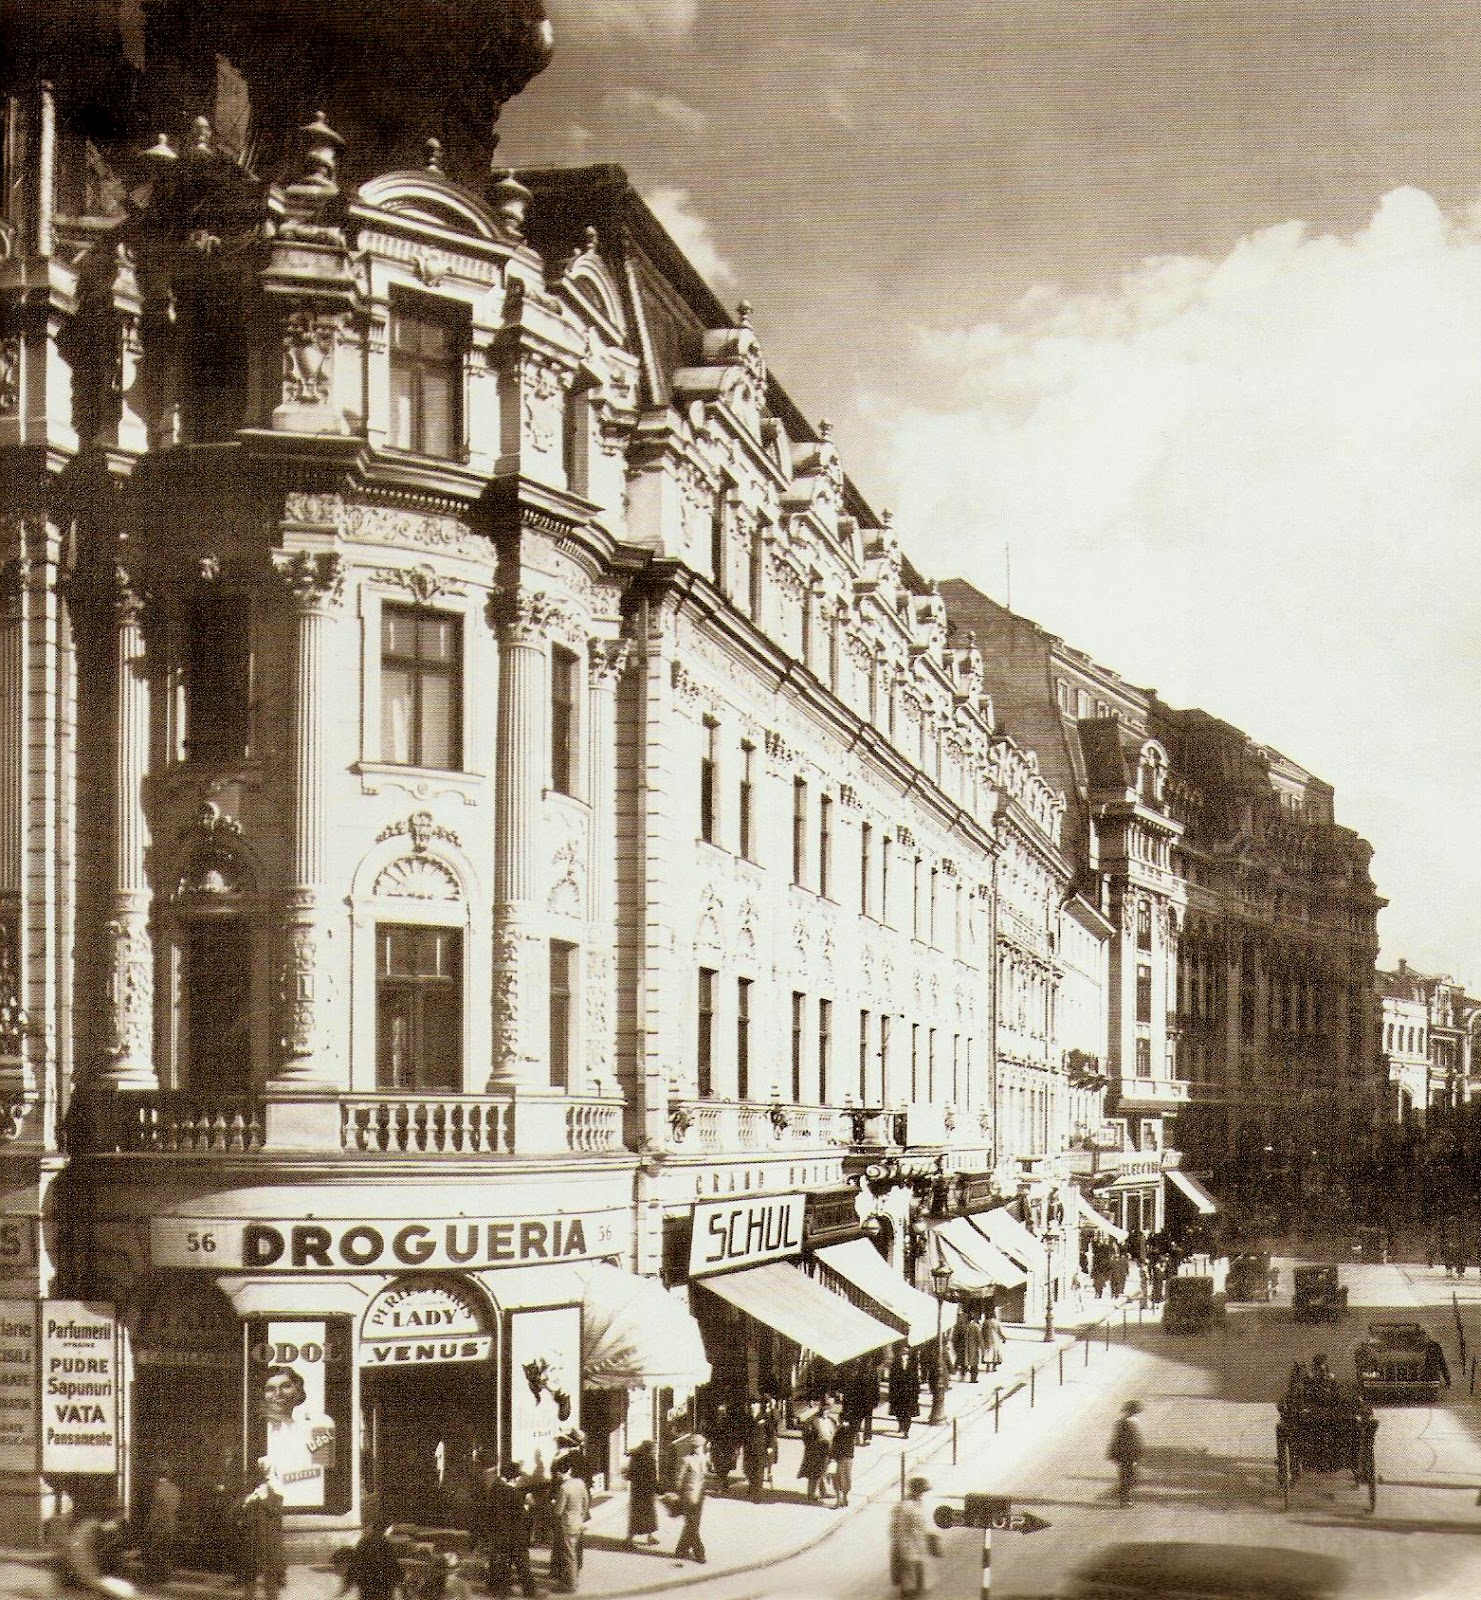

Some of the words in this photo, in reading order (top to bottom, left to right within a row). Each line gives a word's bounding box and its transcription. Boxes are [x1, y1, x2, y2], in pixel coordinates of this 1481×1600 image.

[186, 1233, 216, 1253] 56
[242, 1218, 587, 1267] DROGUERIA
[705, 1204, 798, 1263] SCHUL
[393, 1309, 458, 1327] LADY
[47, 1319, 112, 1340] Parfumerii
[251, 1342, 343, 1364] ODOL
[51, 1357, 110, 1374] PUDRE
[47, 1376, 112, 1399] Sapunuri
[55, 1405, 106, 1423] VATA
